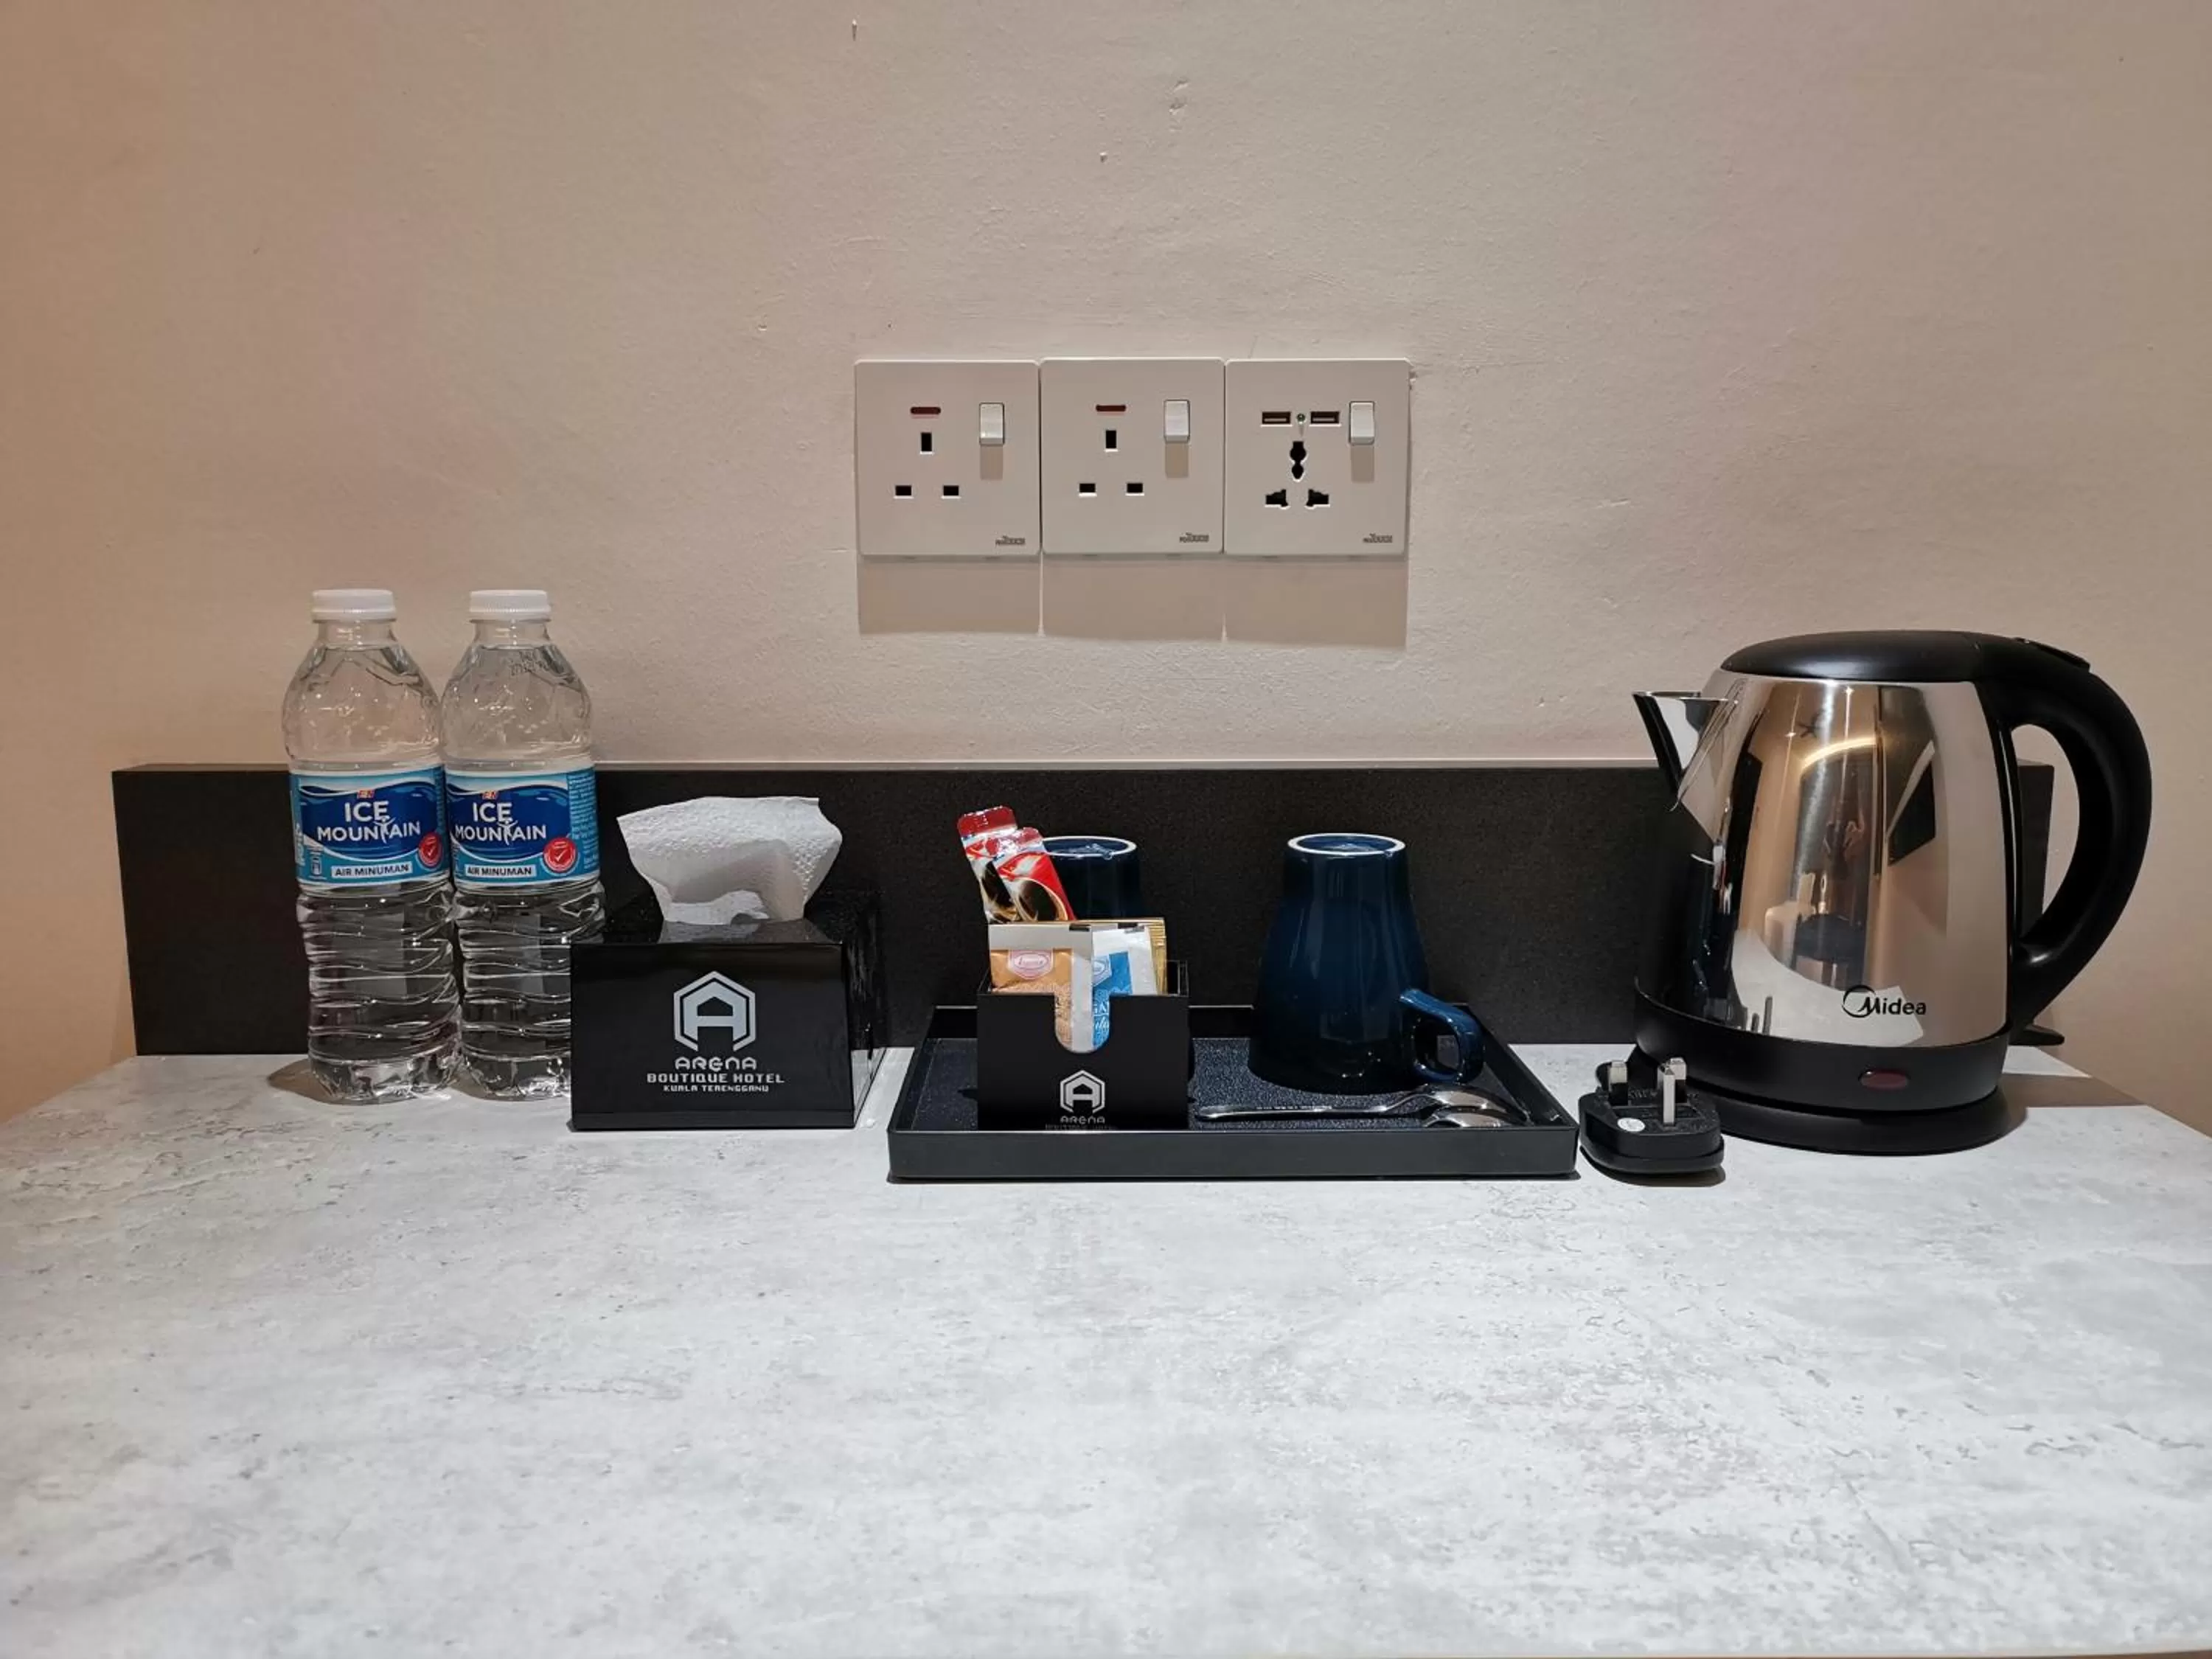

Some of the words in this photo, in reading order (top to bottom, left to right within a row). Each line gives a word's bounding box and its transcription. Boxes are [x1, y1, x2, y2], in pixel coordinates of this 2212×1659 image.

[344, 801, 390, 822] ICE
[473, 801, 513, 822] ICE
[317, 818, 422, 844] MOUNTAIN
[455, 820, 547, 845] MOUNTAIN
[335, 867, 352, 877] AIR
[355, 864, 409, 876] MINUMAN
[467, 866, 480, 875] AIR
[481, 866, 532, 877] MINUMAN
[1843, 987, 1927, 1018] Midea
[647, 1073, 728, 1083] BOUTIQUE
[733, 1073, 785, 1083] HOTEL
